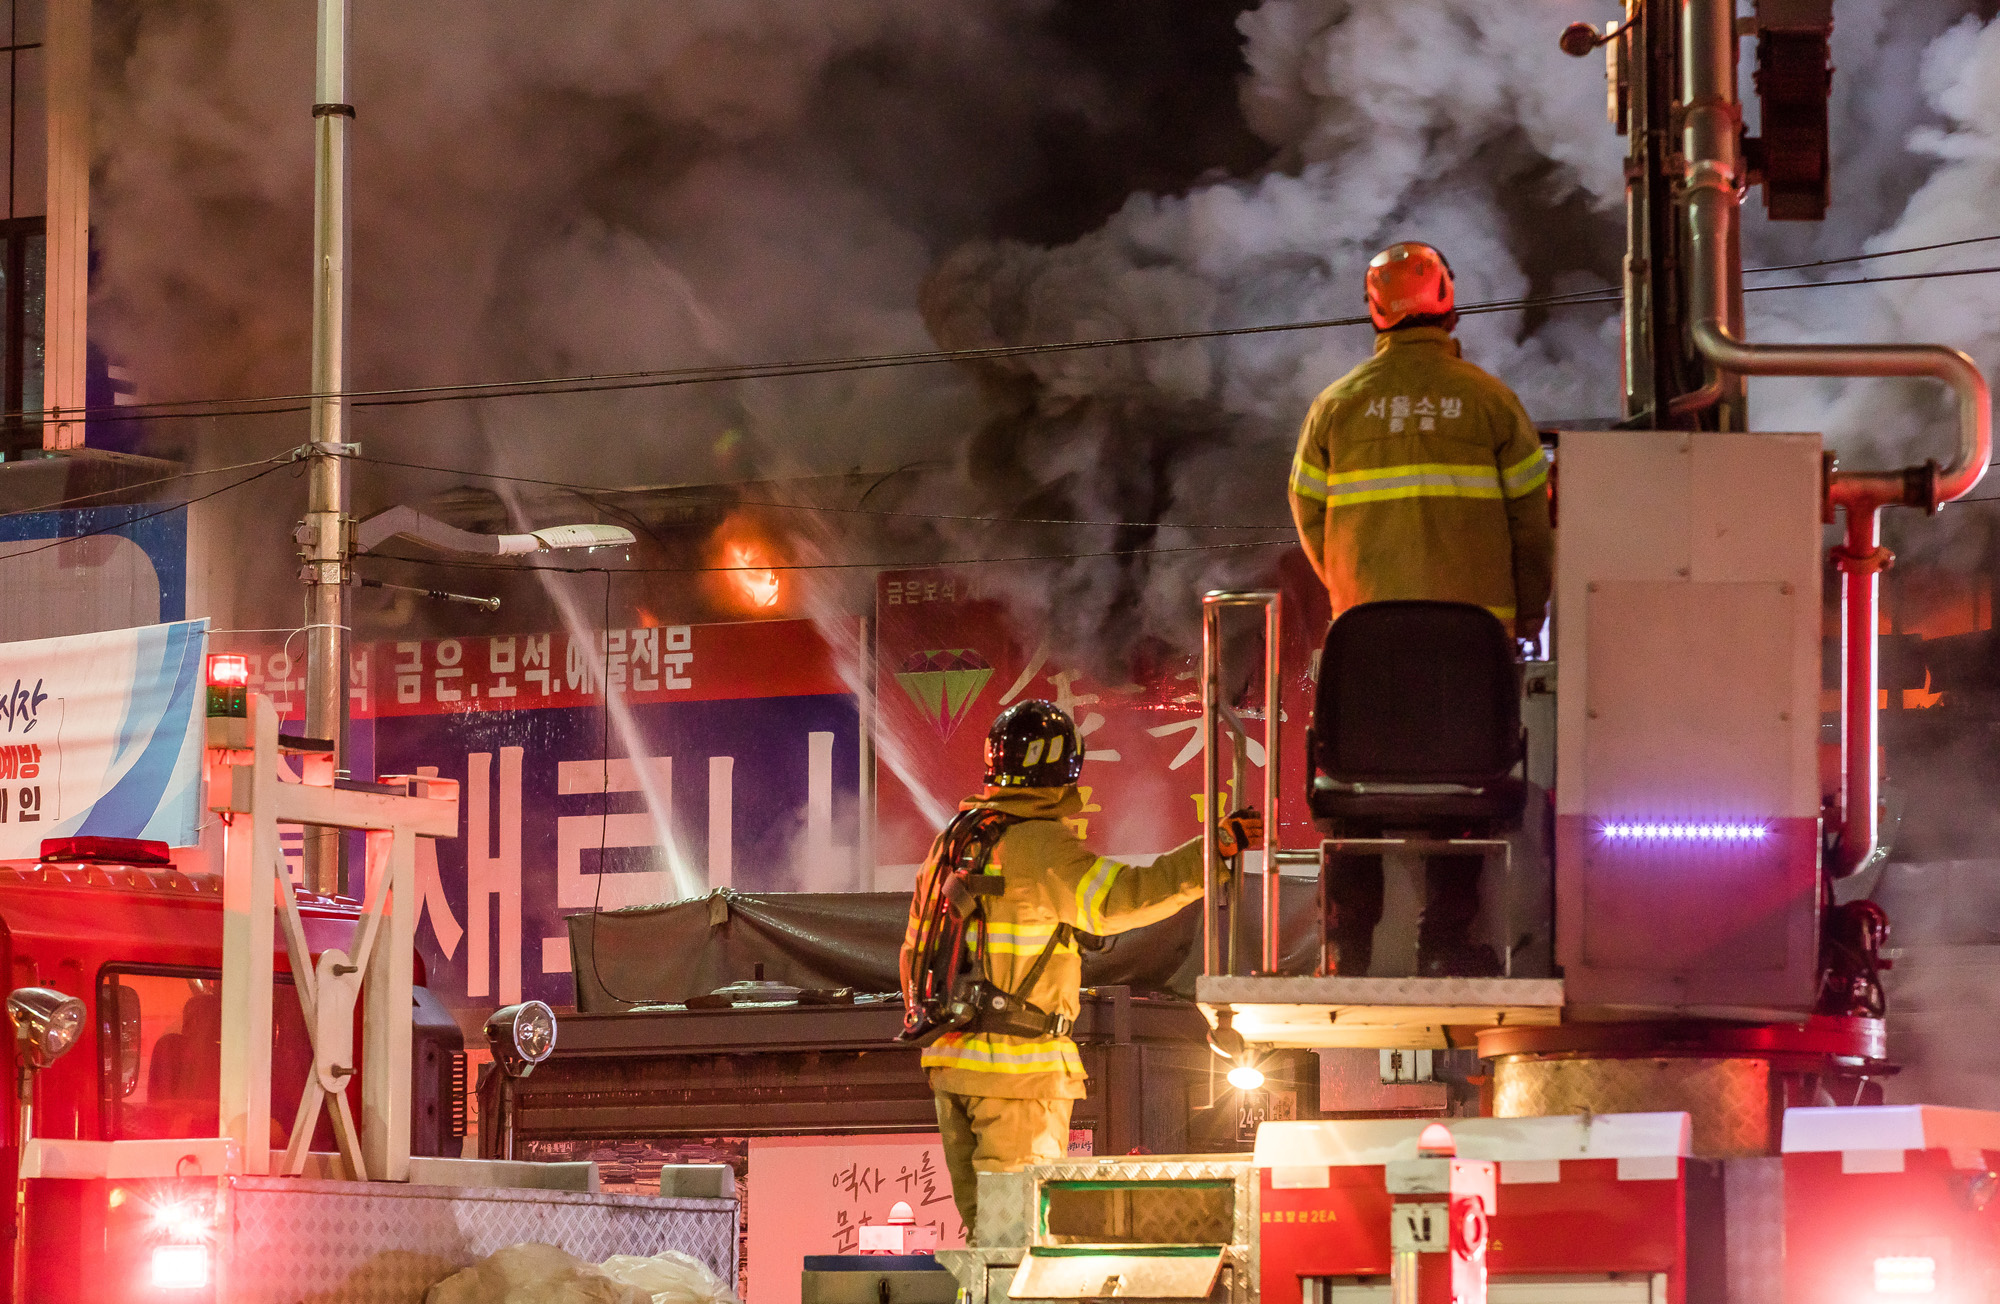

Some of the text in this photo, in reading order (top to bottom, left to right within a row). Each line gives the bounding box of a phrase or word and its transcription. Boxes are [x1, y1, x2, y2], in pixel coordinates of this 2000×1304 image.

[1364, 396, 1462, 420] 서울소방
[832, 1150, 953, 1207] 역사 위를
[832, 1210, 873, 1254] 문
